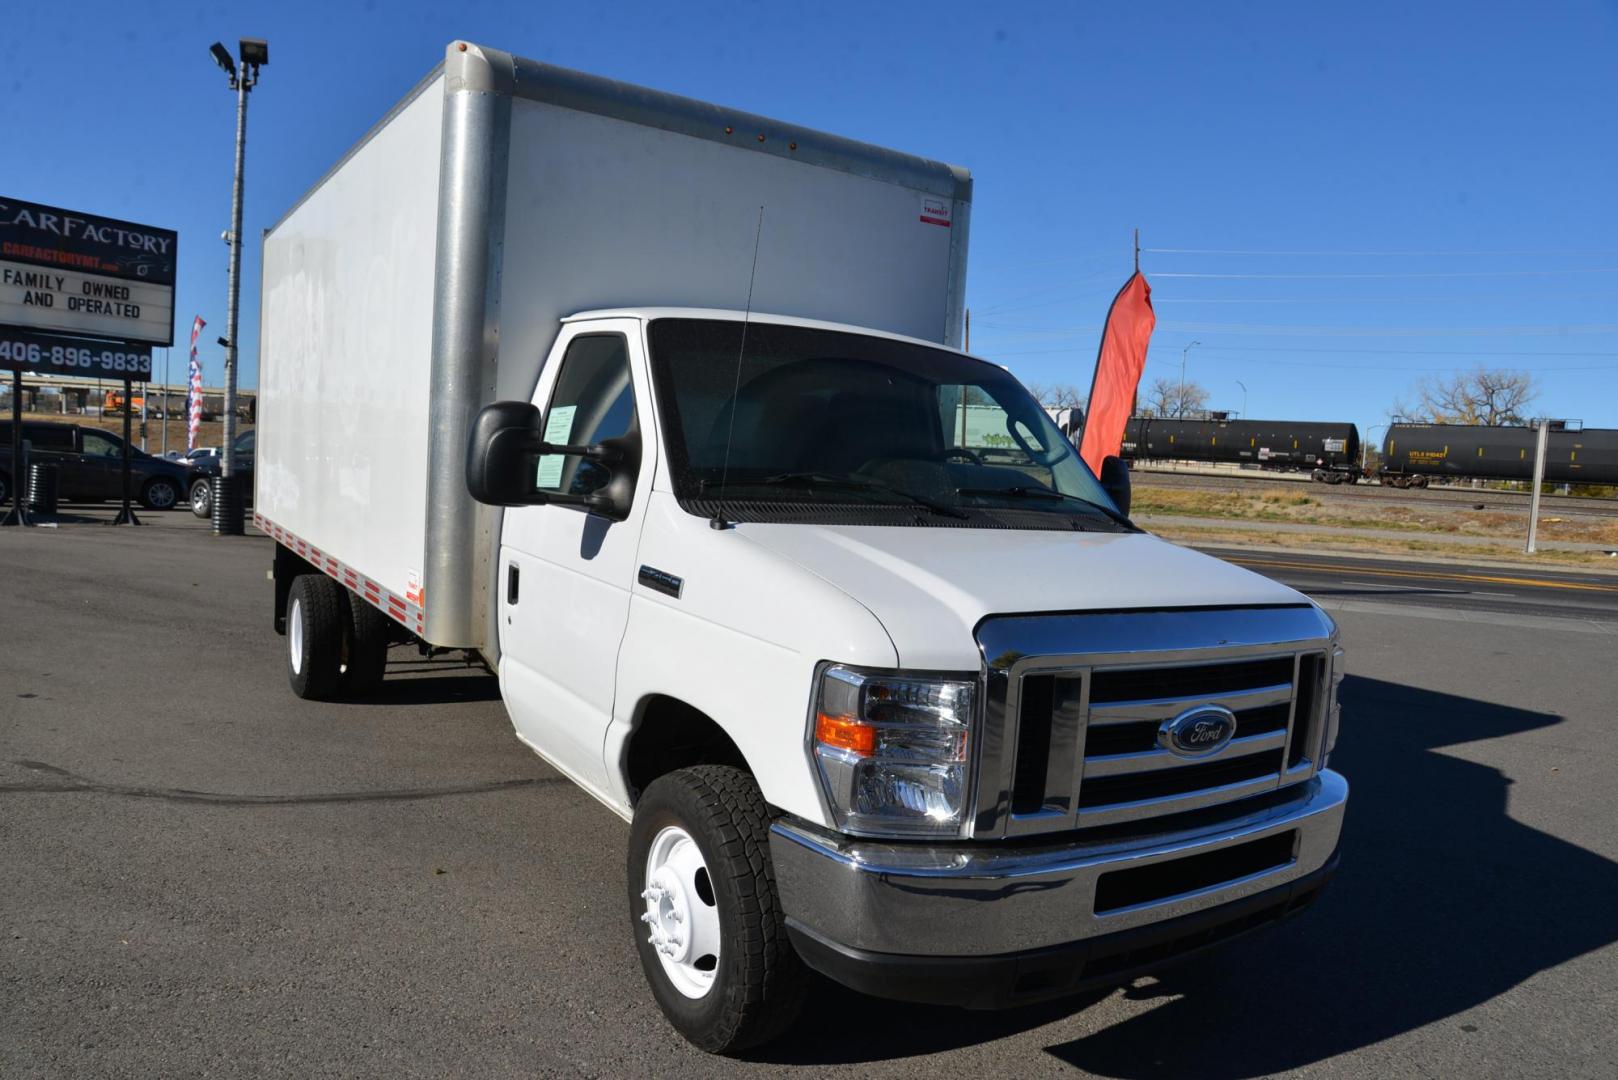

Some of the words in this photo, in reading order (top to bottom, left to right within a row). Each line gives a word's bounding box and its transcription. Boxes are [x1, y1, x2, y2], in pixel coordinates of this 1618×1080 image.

[3, 269, 65, 291] FAMILY
[82, 281, 130, 300] OWNED
[23, 291, 54, 307] AND
[68, 296, 141, 319] OPERATED
[0, 341, 150, 373] 406-896-9833
[1190, 721, 1223, 743] Ford
